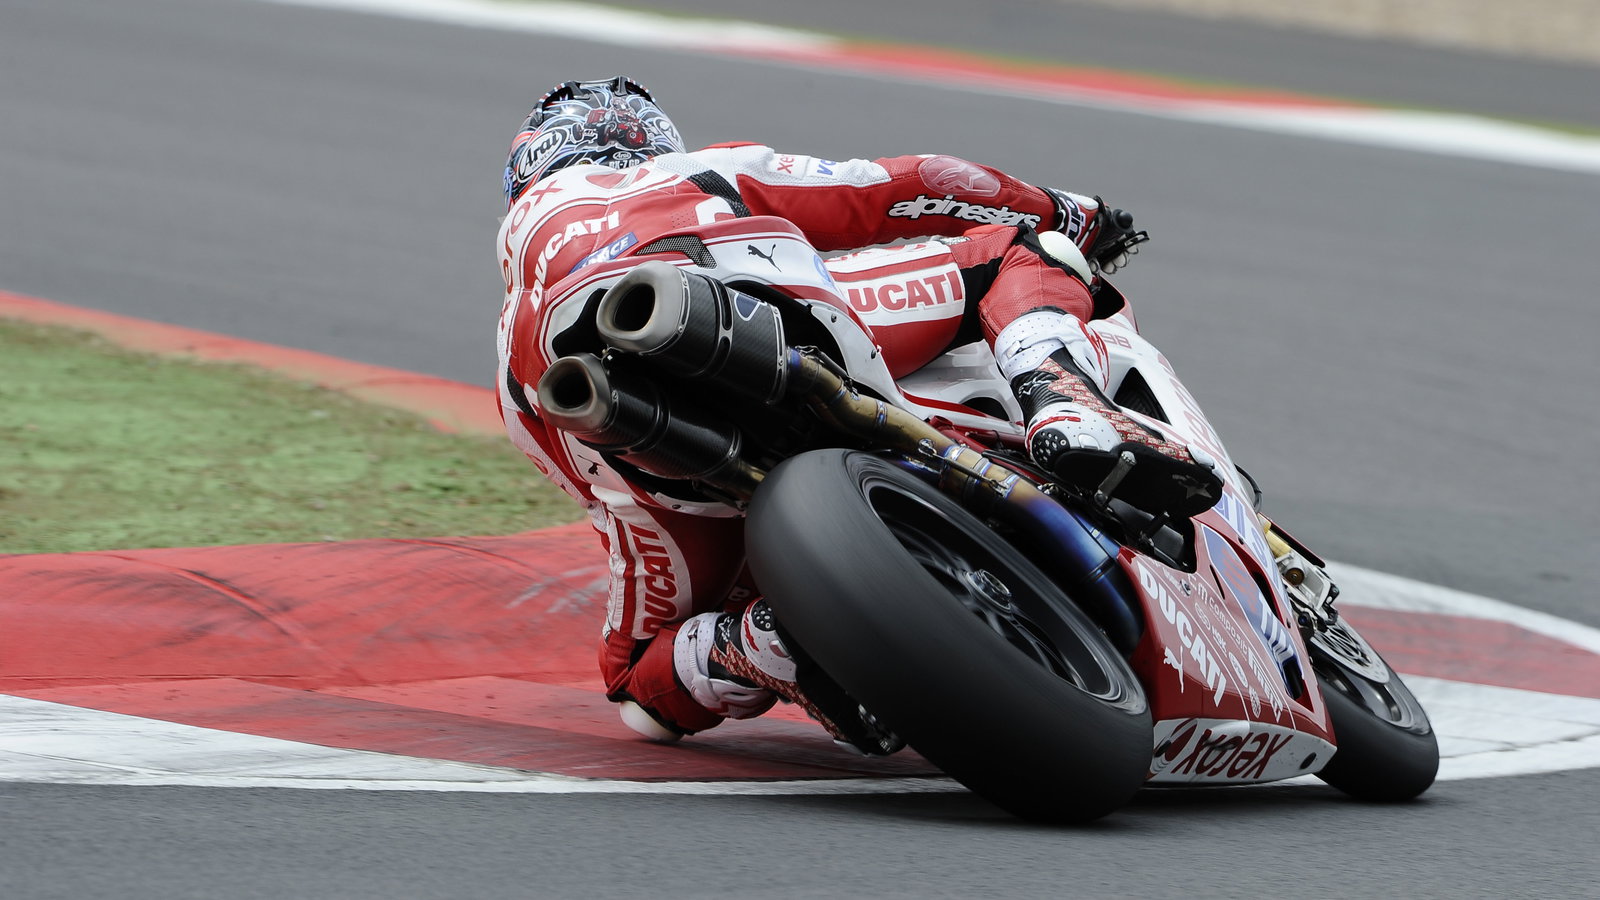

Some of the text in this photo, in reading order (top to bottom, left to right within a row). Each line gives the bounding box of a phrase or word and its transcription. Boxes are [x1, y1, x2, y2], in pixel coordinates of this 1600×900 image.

[521, 130, 560, 178] Arai
[888, 194, 1041, 229] alpinestars
[530, 211, 621, 312] DUCATI
[847, 270, 963, 312] UCATI
[628, 523, 678, 635] DUCATI
[1137, 560, 1227, 707] DUCATI
[1247, 646, 1284, 723] PIRELLI
[1171, 728, 1294, 779] xerox
